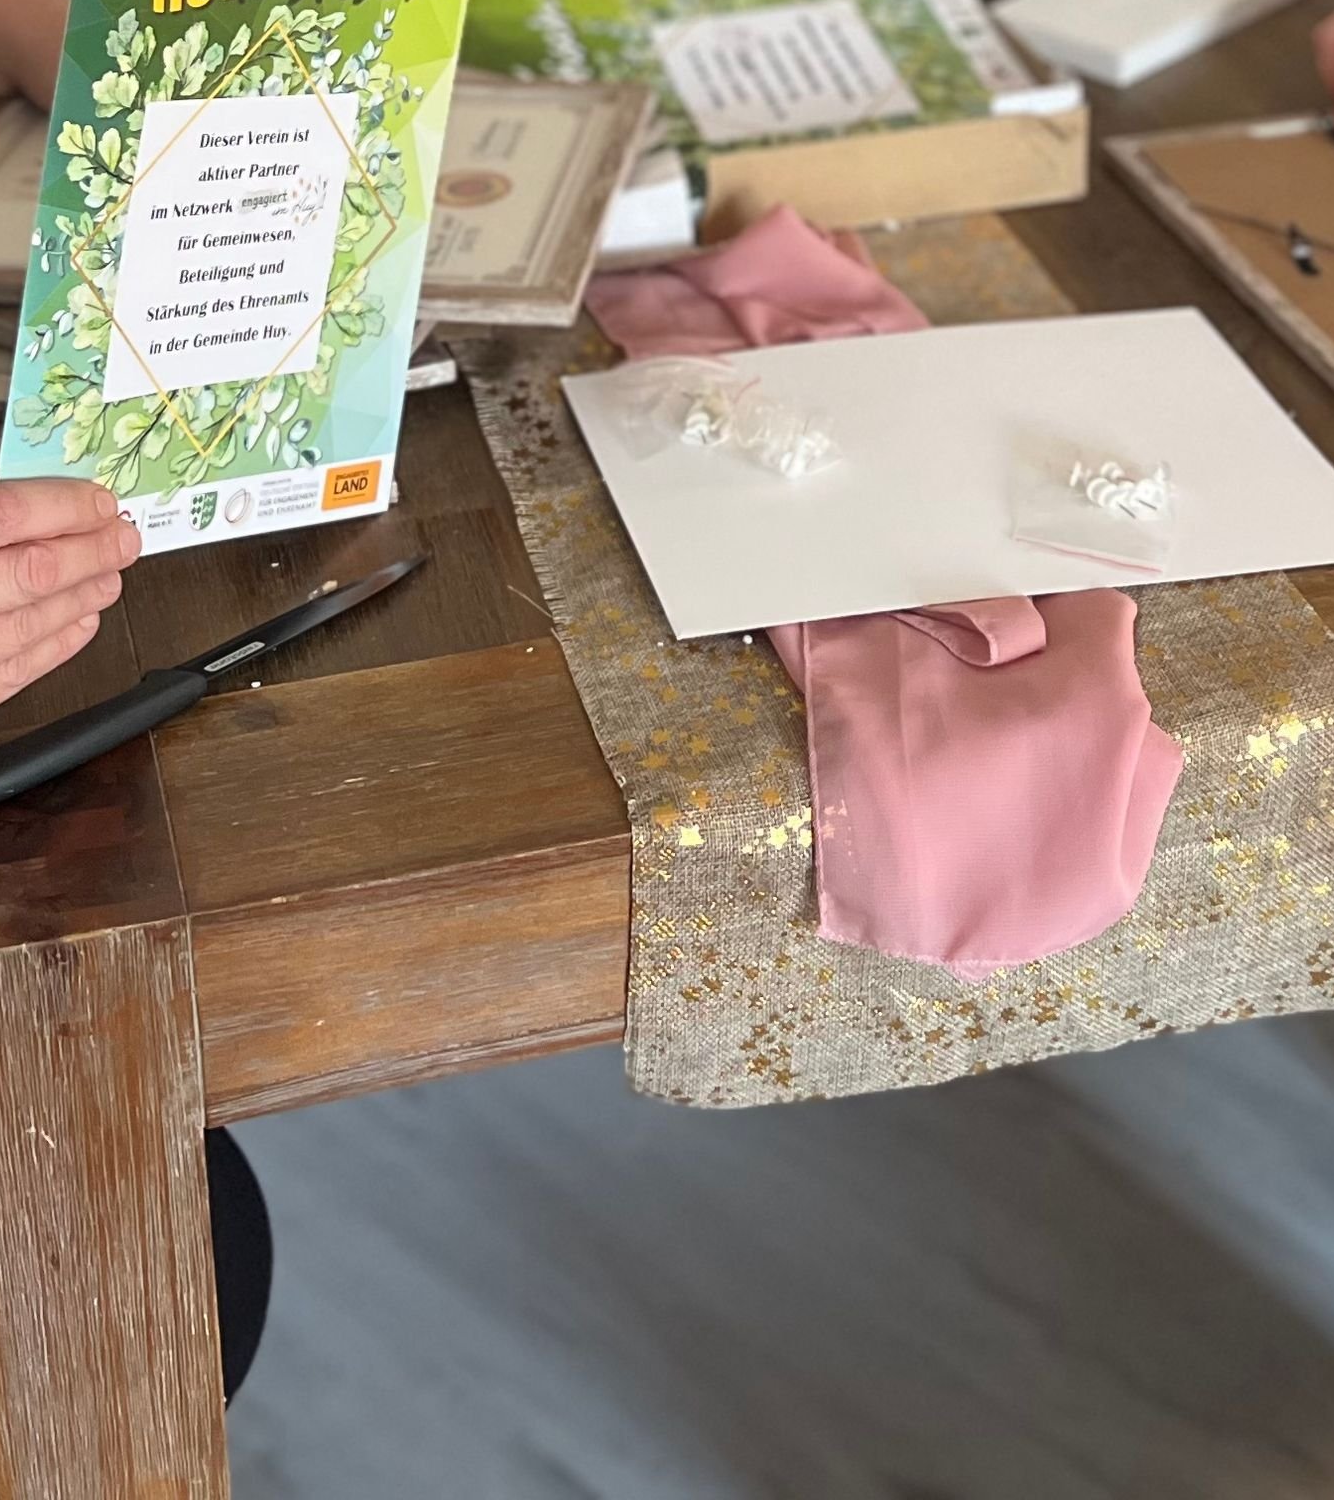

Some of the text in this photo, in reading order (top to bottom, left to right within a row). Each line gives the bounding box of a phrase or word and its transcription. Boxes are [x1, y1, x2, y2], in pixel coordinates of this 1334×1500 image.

[200, 128, 310, 148] Dieser Verein ist
[198, 163, 300, 182] aktiver Partner
[150, 189, 288, 220] im Netzwerk engagiert
[177, 229, 296, 251] für Gemeinwesen,
[179, 259, 285, 284] Beteiligung und
[146, 290, 309, 322] Stärkung des Ehrenamts
[149, 325, 292, 355] in der Gemeinde Huy.
[334, 476, 369, 495] LAND
